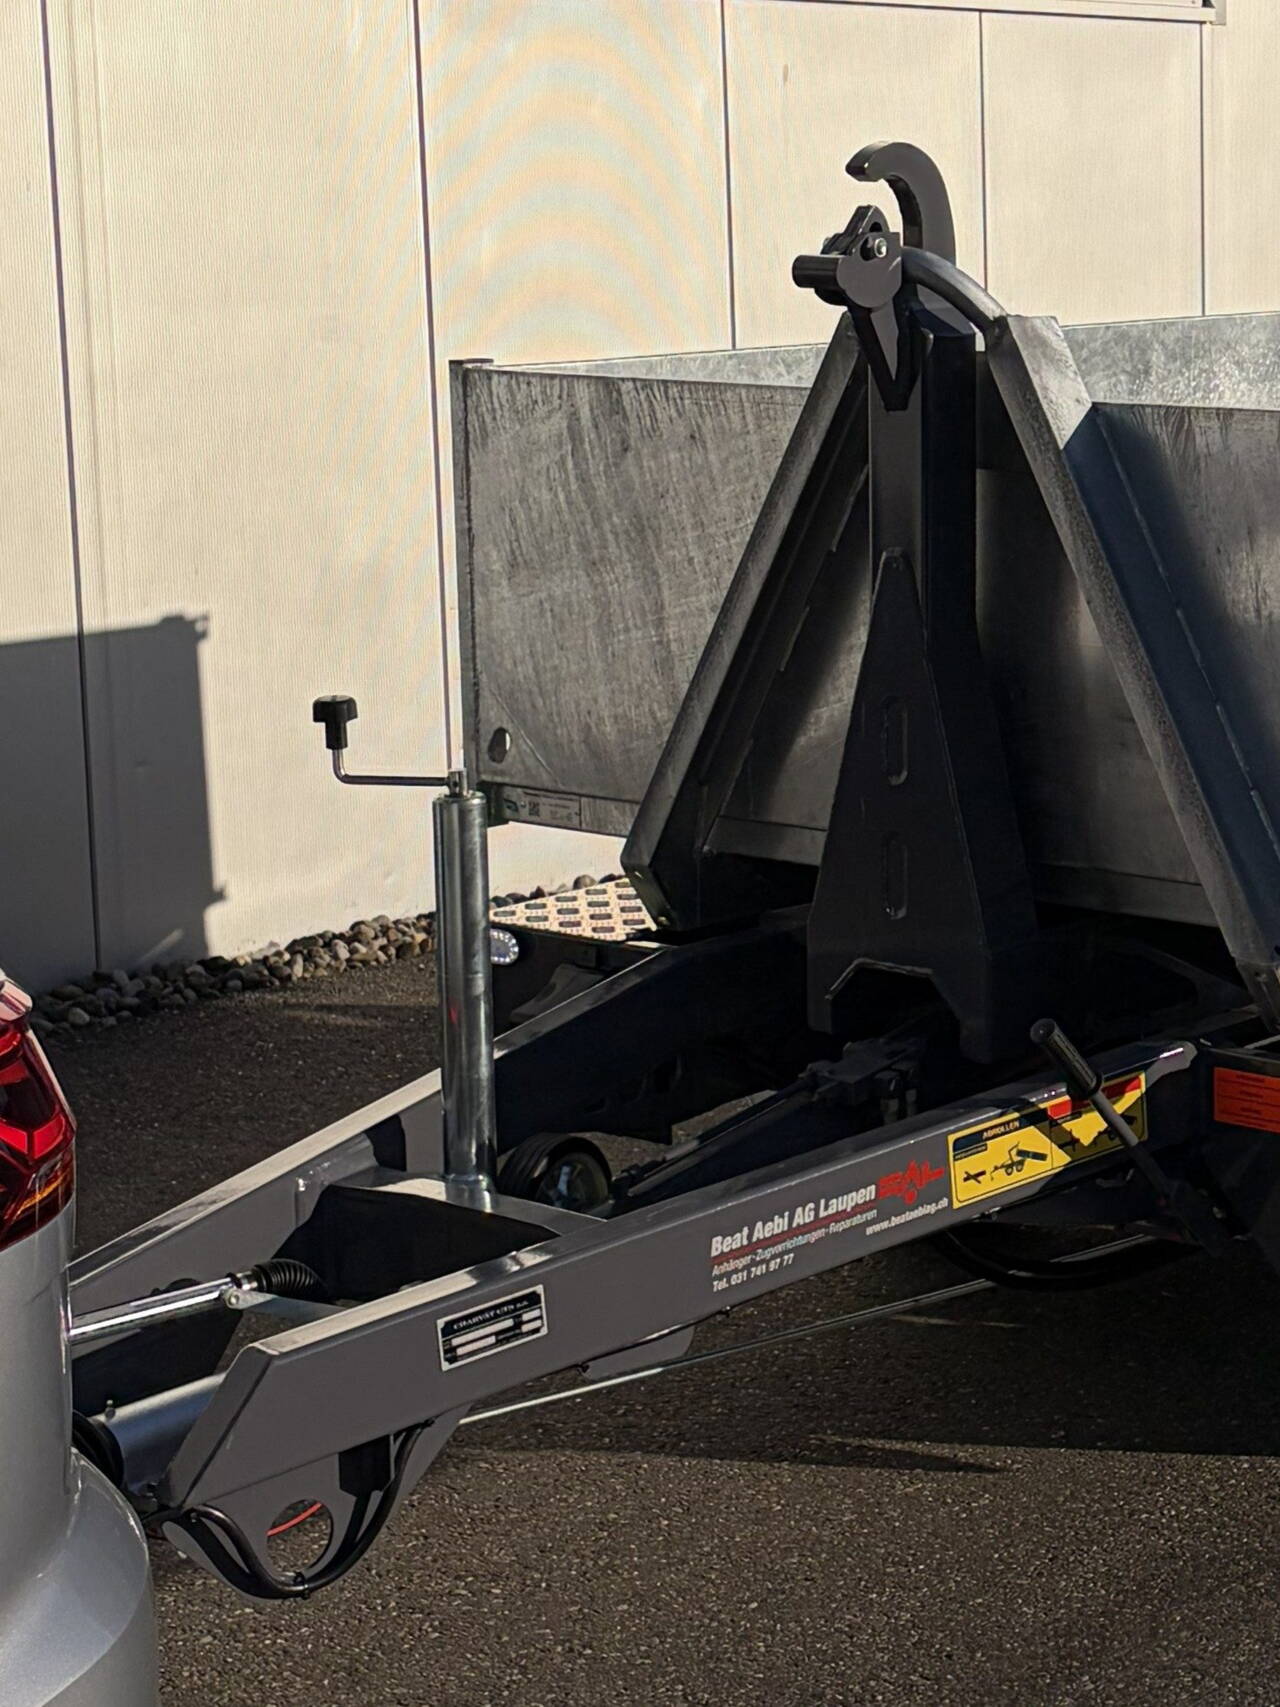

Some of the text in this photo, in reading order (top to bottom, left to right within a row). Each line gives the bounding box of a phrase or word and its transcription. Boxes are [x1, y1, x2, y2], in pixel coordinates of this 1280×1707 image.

[710, 1184, 876, 1257] Beat Aebi AG Laupen
[713, 1277, 729, 1292] Tel.
[730, 1270, 748, 1286] 031
[750, 1263, 767, 1279] 741
[782, 1253, 795, 1267] 77
